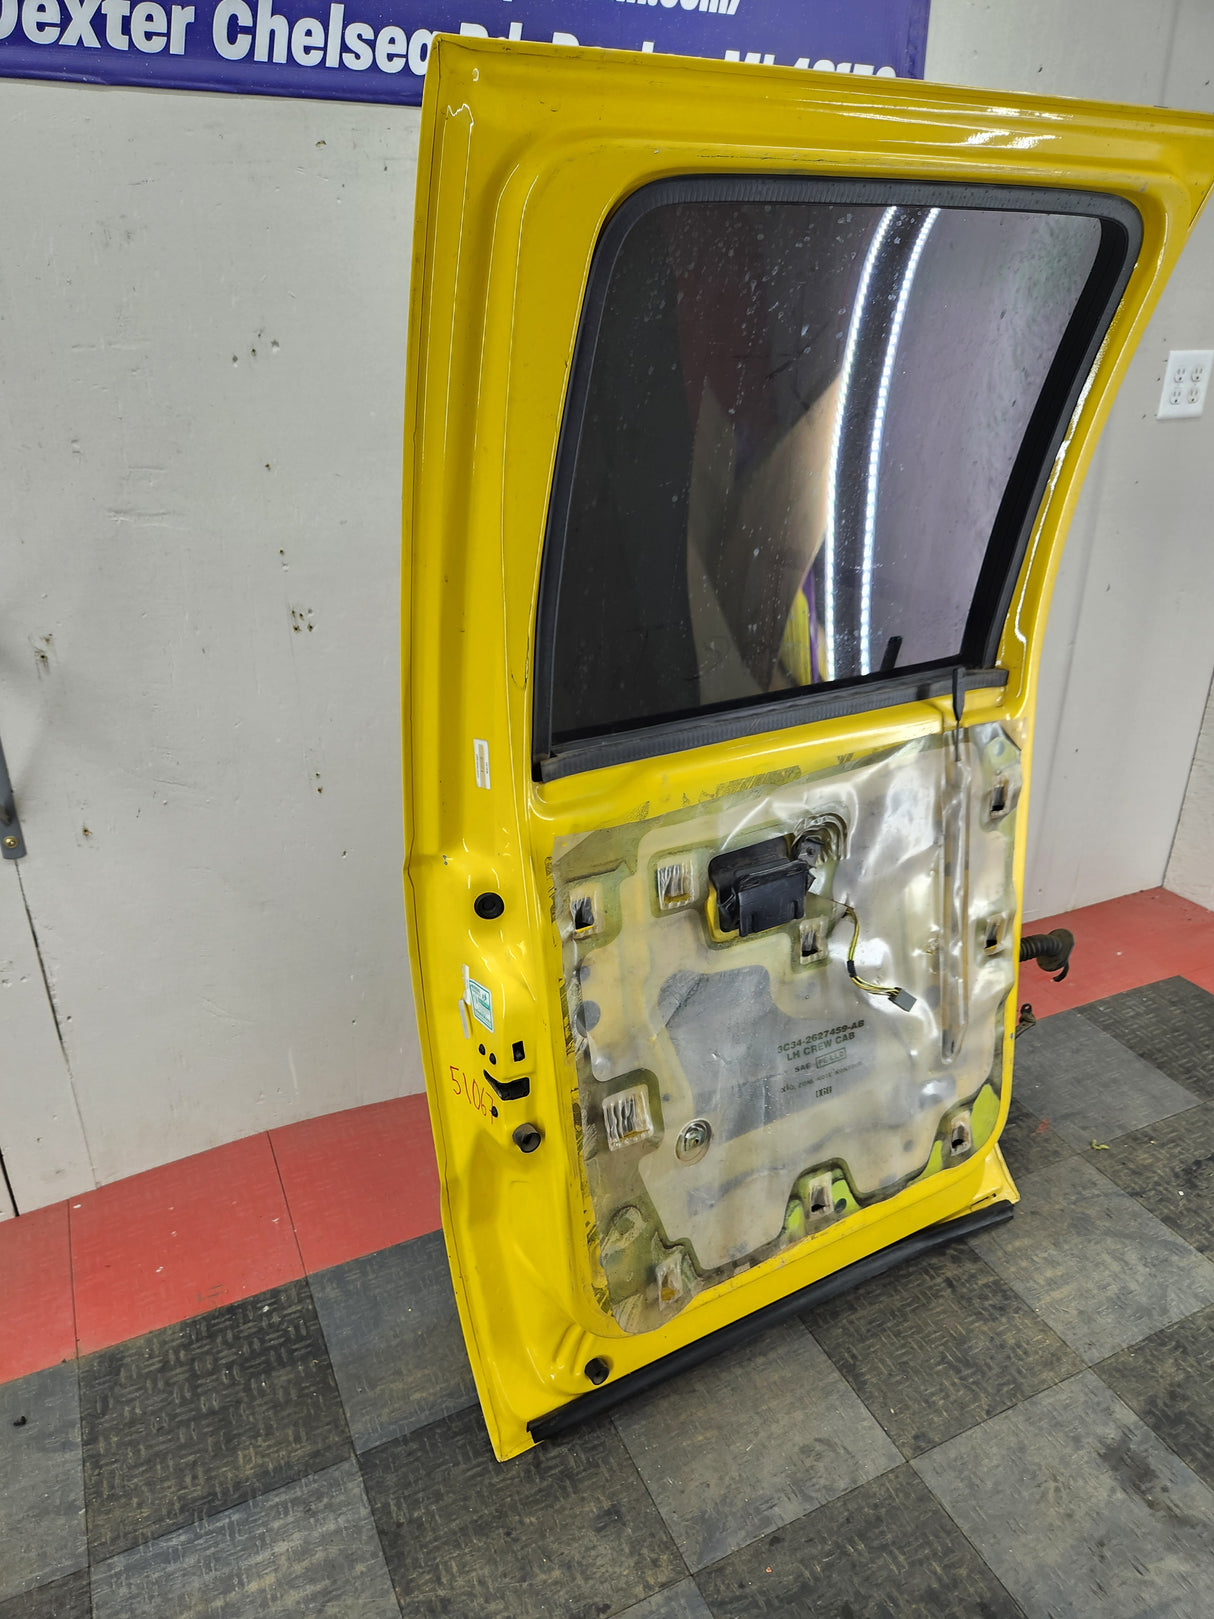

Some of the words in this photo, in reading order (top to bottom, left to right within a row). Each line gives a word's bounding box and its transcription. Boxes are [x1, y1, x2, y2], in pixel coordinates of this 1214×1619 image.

[777, 1020, 865, 1054] 3C34-2627459-AB
[786, 1051, 800, 1061] LH
[803, 1039, 832, 1056] CREW
[835, 1032, 855, 1045] CAB
